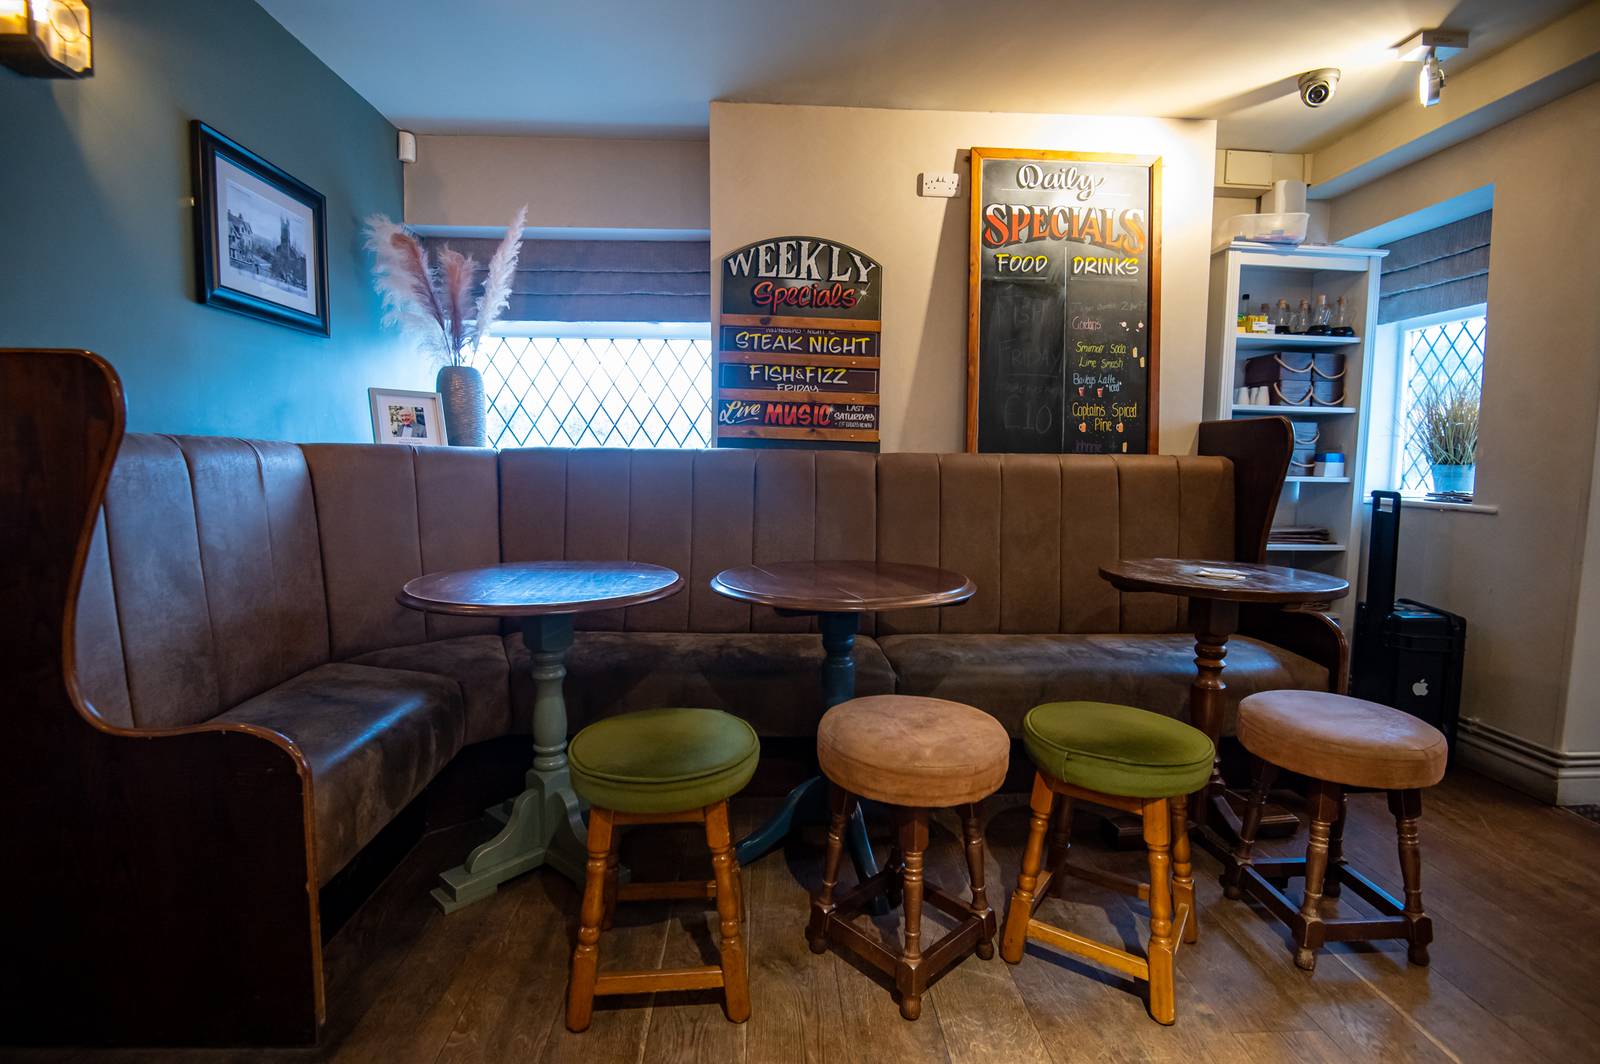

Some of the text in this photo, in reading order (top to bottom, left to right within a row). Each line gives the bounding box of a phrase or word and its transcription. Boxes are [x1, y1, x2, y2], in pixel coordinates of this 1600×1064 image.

[1017, 163, 1105, 201] Daily
[983, 203, 1146, 256] SPECIALS
[727, 239, 878, 284] WEEKLY
[994, 253, 1140, 276] FOOD DRINKS
[751, 280, 858, 313] Specials
[735, 331, 803, 352] STEAK
[809, 335, 871, 355] NIGHT
[719, 399, 834, 426] Live MUSIC
[833, 412, 875, 422] SATURDAY
[845, 404, 865, 412] LAST
